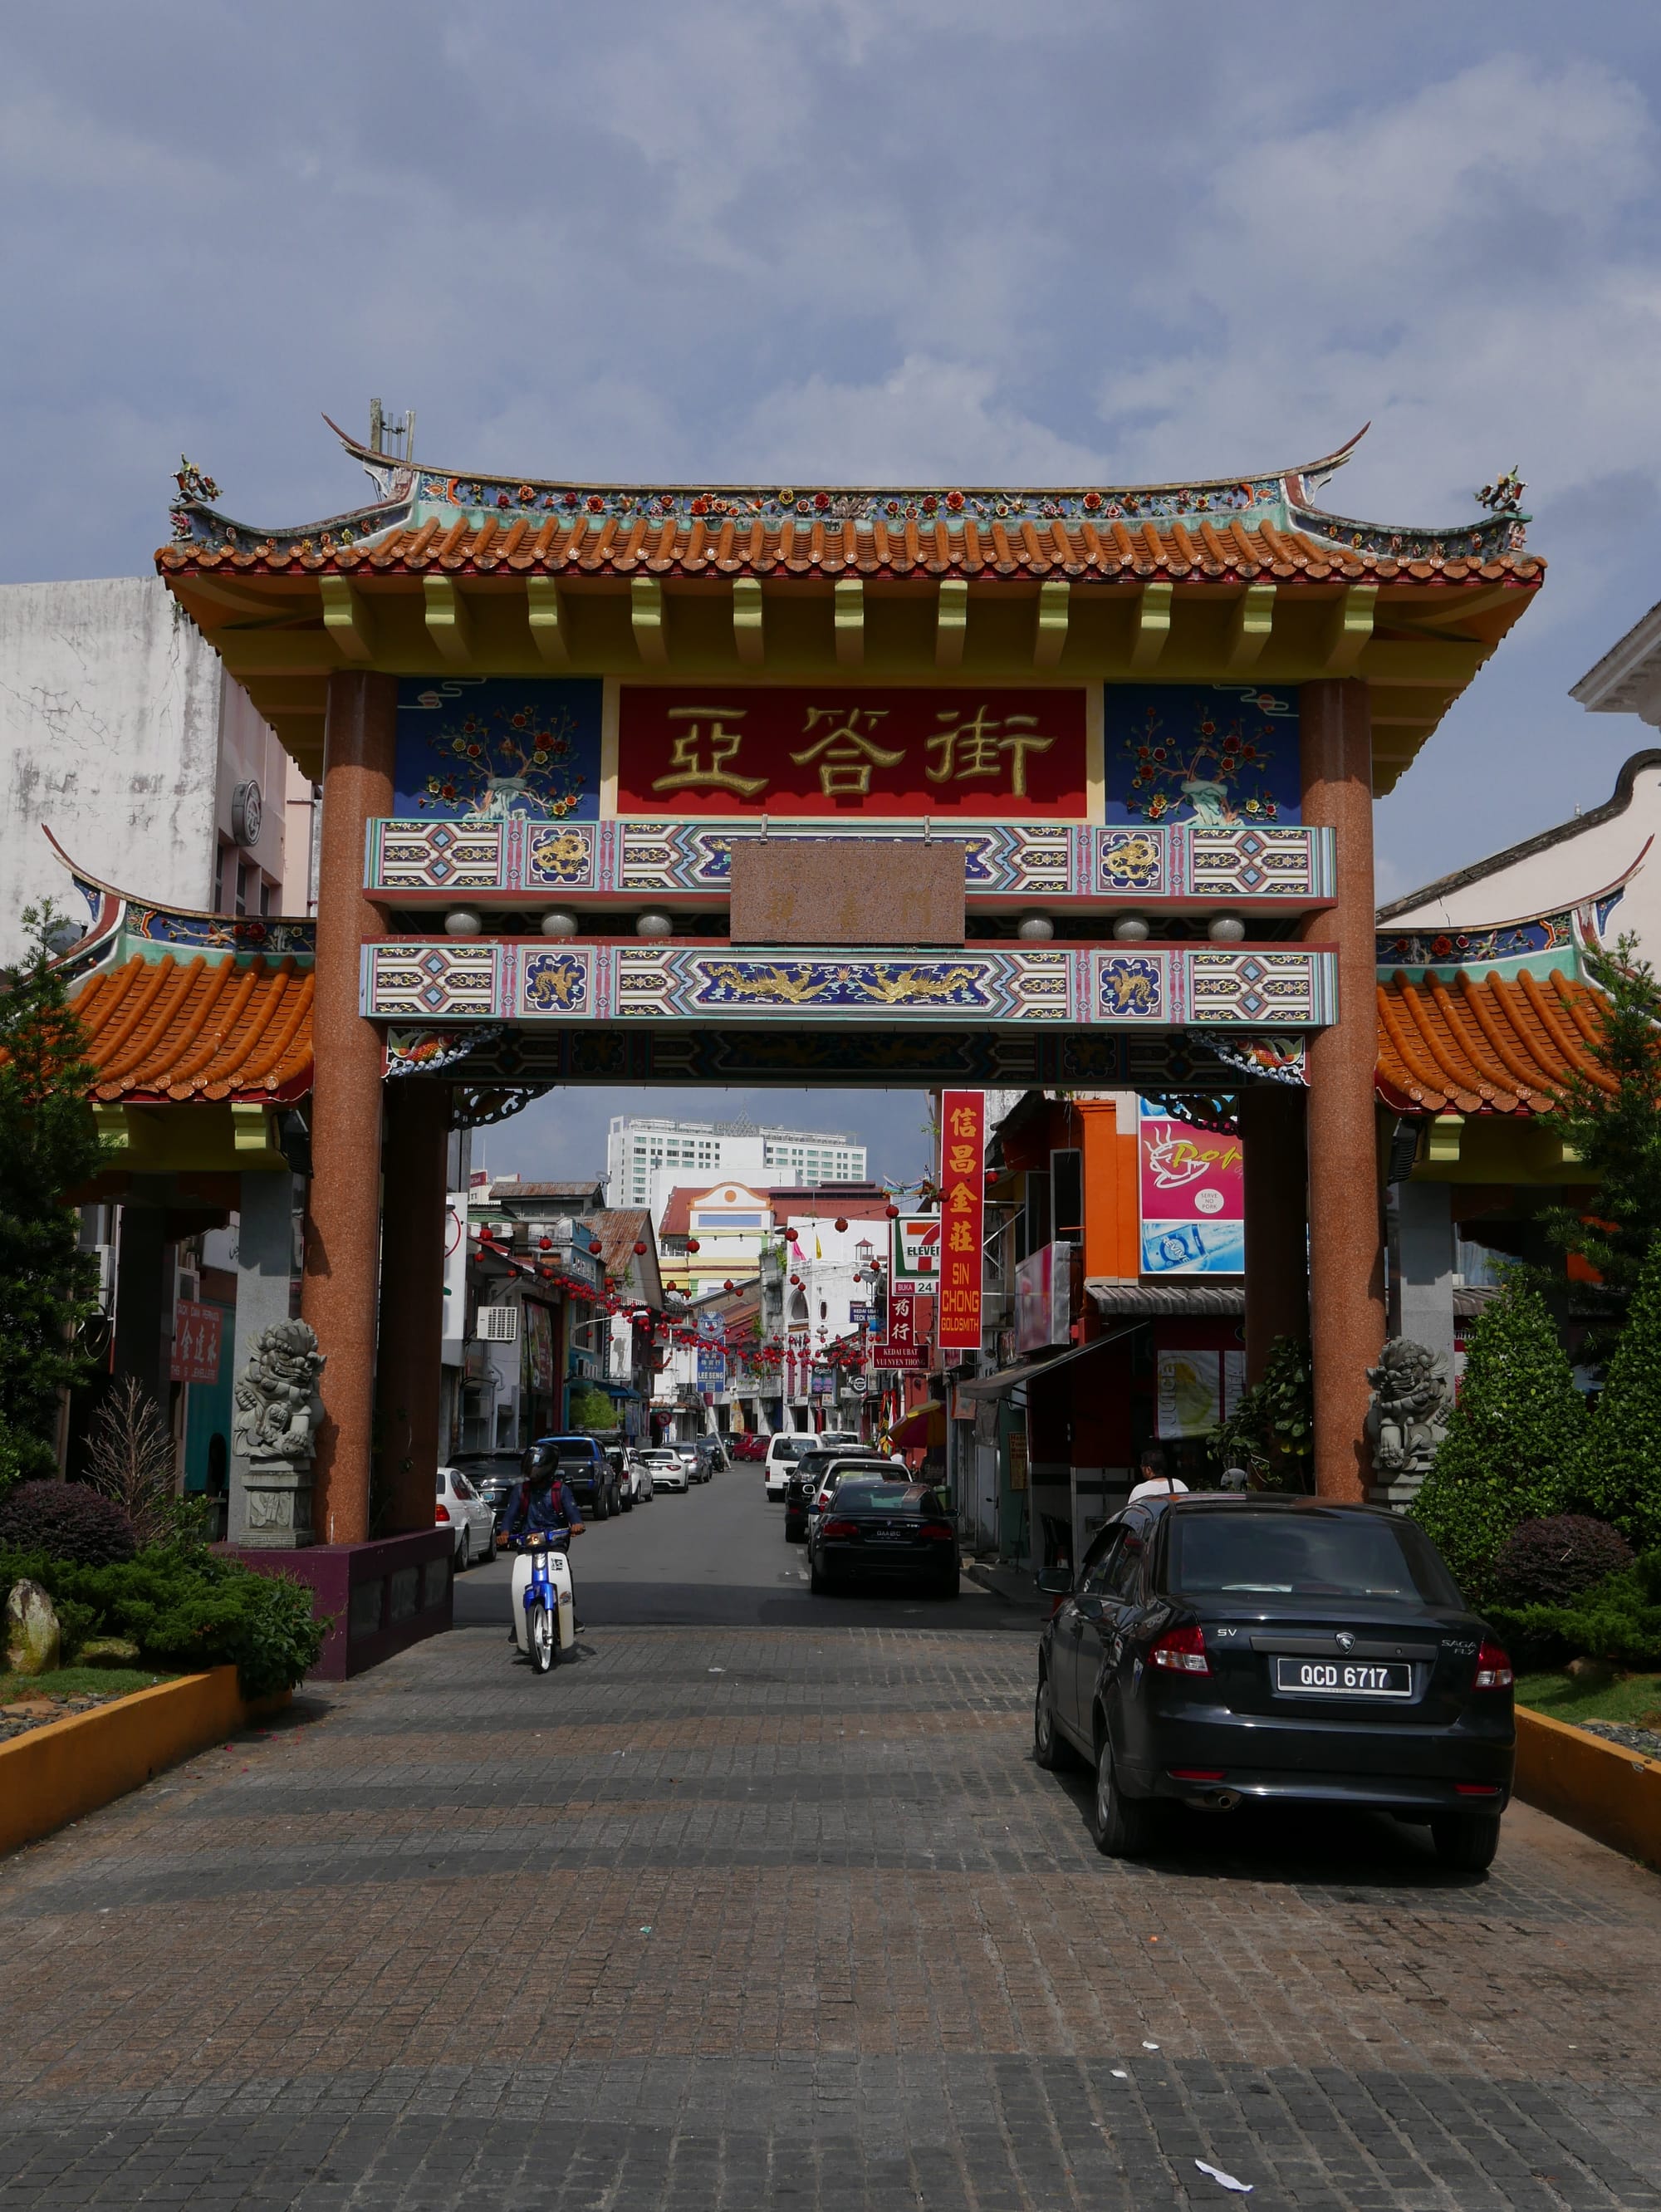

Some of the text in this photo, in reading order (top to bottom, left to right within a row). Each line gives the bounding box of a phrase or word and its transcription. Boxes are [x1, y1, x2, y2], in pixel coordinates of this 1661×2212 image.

[948, 1107, 978, 1252] 信昌金莊
[1162, 1235, 1190, 1263] REVIVE
[952, 1263, 970, 1285] SIN
[918, 1283, 932, 1292] 24
[942, 1290, 980, 1312] CHONG
[942, 1317, 979, 1332] GOLDSMITH
[1217, 1628, 1237, 1636] SV
[1441, 1640, 1476, 1649] SAGA
[1301, 1665, 1388, 1689] QCD 6717
